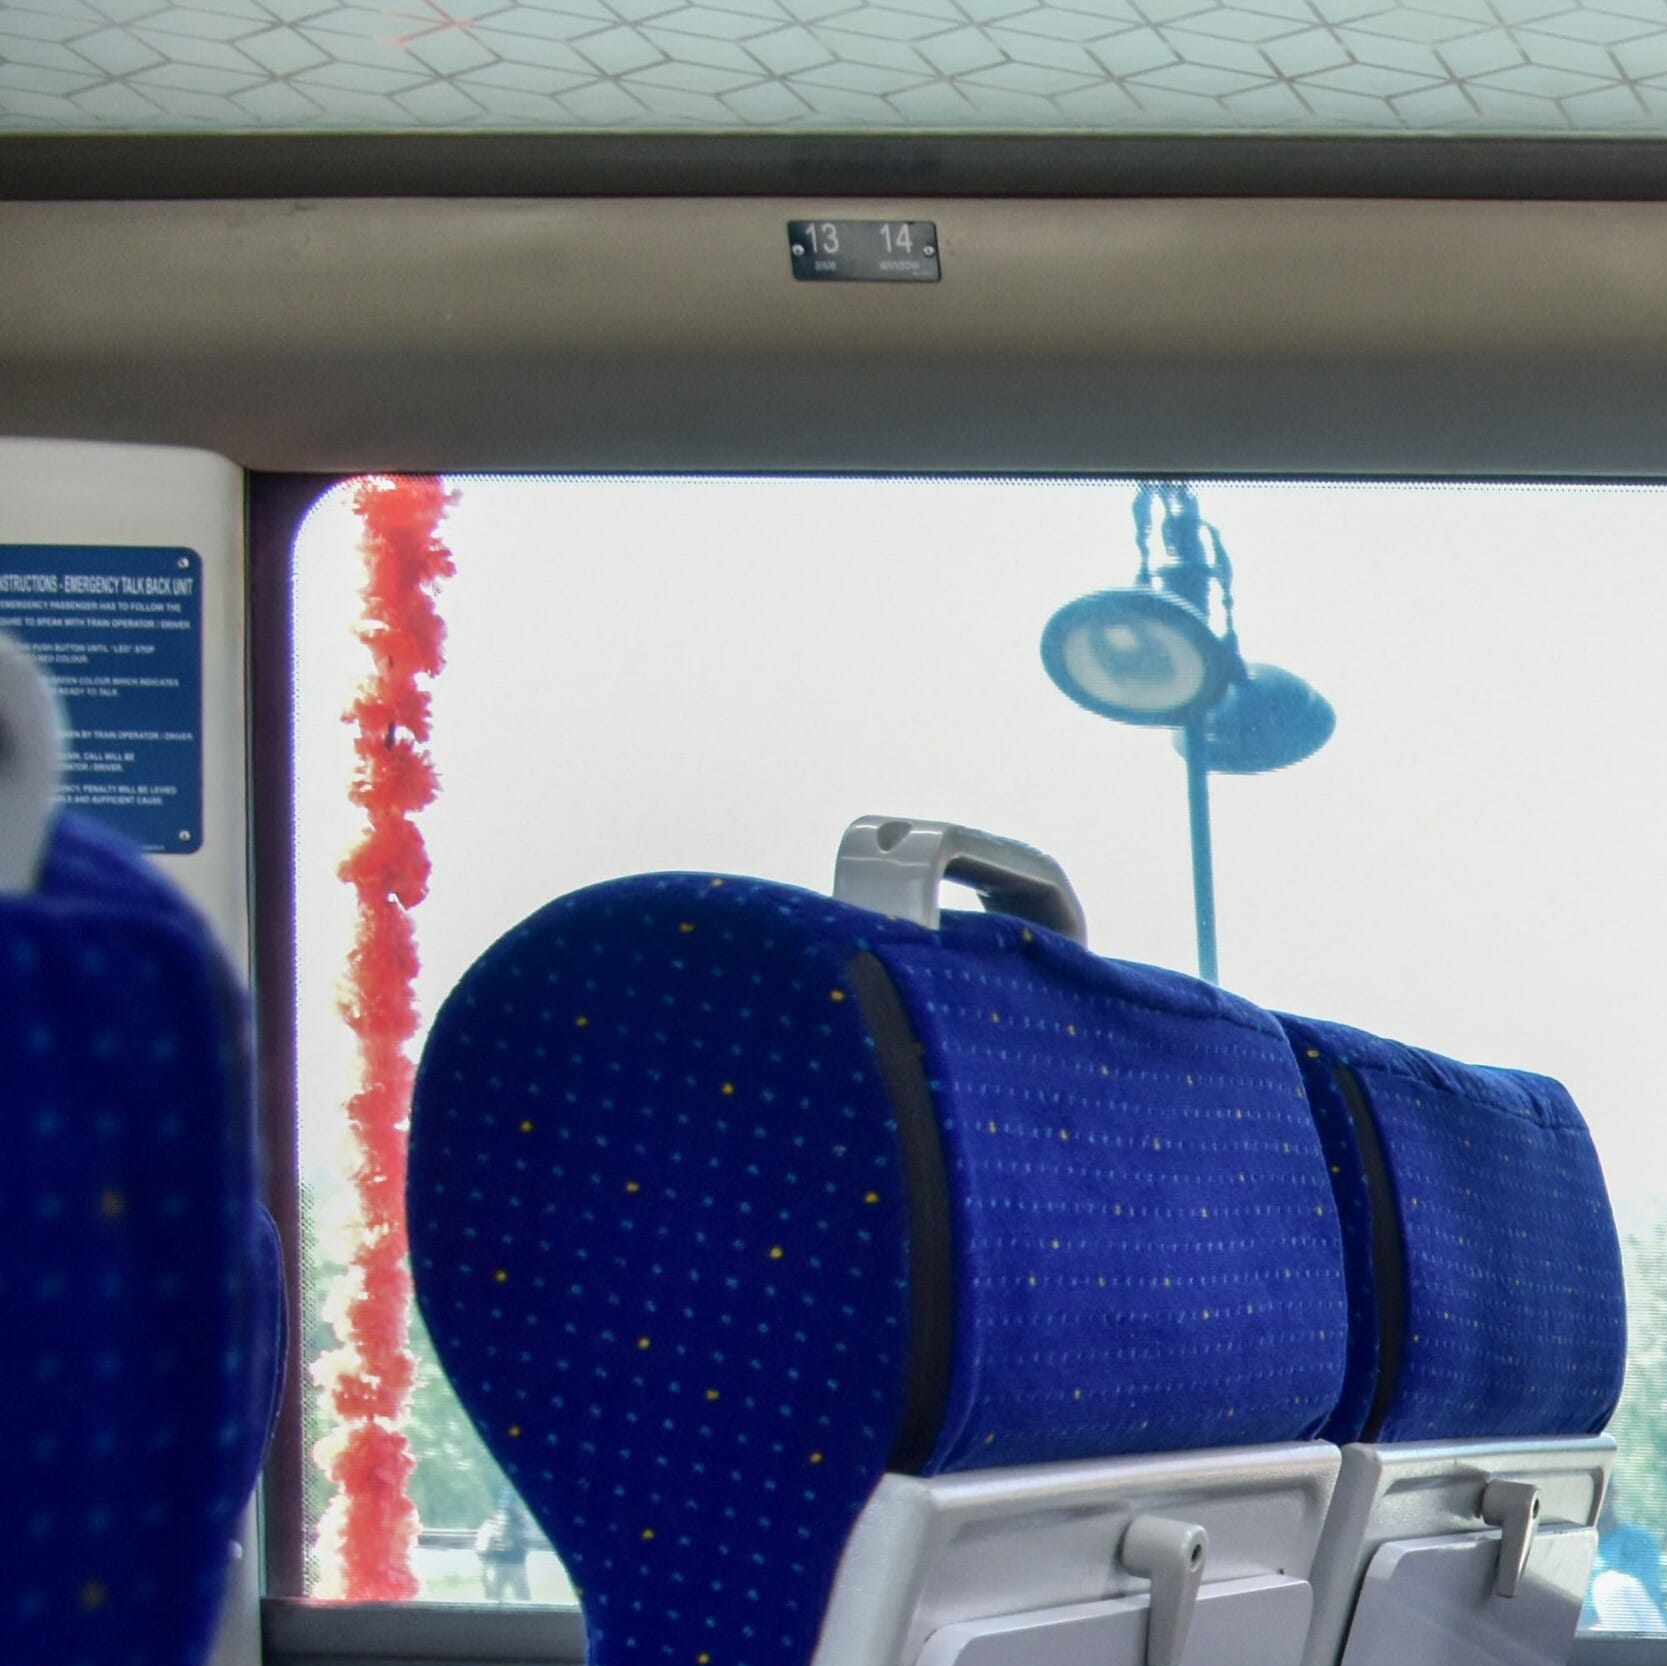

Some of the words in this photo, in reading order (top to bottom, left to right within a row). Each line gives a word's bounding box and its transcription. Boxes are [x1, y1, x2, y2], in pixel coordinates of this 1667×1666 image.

[806, 222, 840, 254] 13
[880, 222, 913, 254] 14
[65, 575, 119, 594] EMERGENCY
[122, 576, 145, 595] TALK
[146, 577, 171, 595] BACK
[172, 577, 193, 596] UNIT
